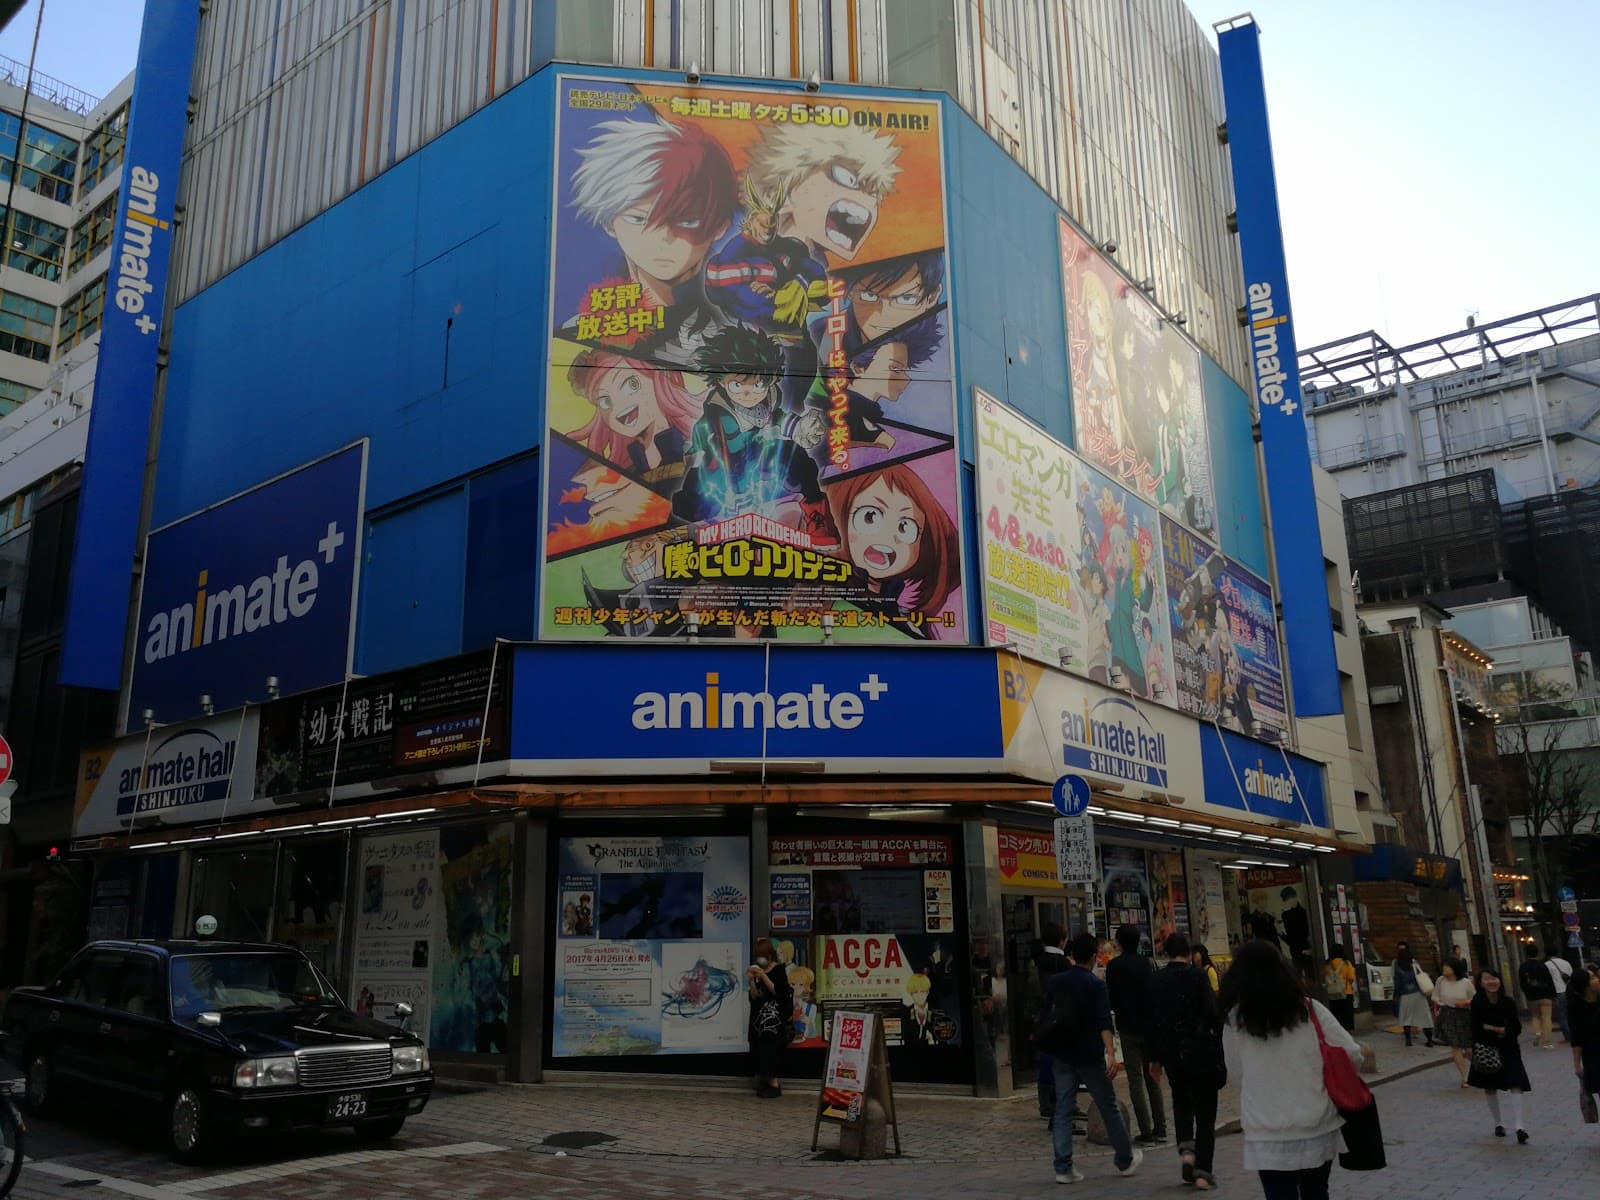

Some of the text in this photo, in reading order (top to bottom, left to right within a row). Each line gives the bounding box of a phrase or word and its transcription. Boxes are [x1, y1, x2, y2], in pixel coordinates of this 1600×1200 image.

[853, 111, 882, 128] ON
[886, 112, 929, 130] AIR!
[590, 283, 642, 313] 好評
[576, 305, 665, 341] 放送中!
[981, 417, 1073, 499] エロマンガ
[1010, 472, 1054, 527] 先生
[700, 516, 811, 548] MY HERO ACADEMIA
[1004, 670, 1026, 702] B2
[308, 692, 394, 747] 幼女戦記
[1061, 697, 1136, 759] animate
[1137, 727, 1166, 766] hall
[198, 741, 236, 780] hall
[1089, 751, 1149, 783] SHINJUKU
[141, 783, 206, 812] SHINJUKU
[1248, 873, 1274, 882] ACCA
[823, 938, 902, 969] ACCA
